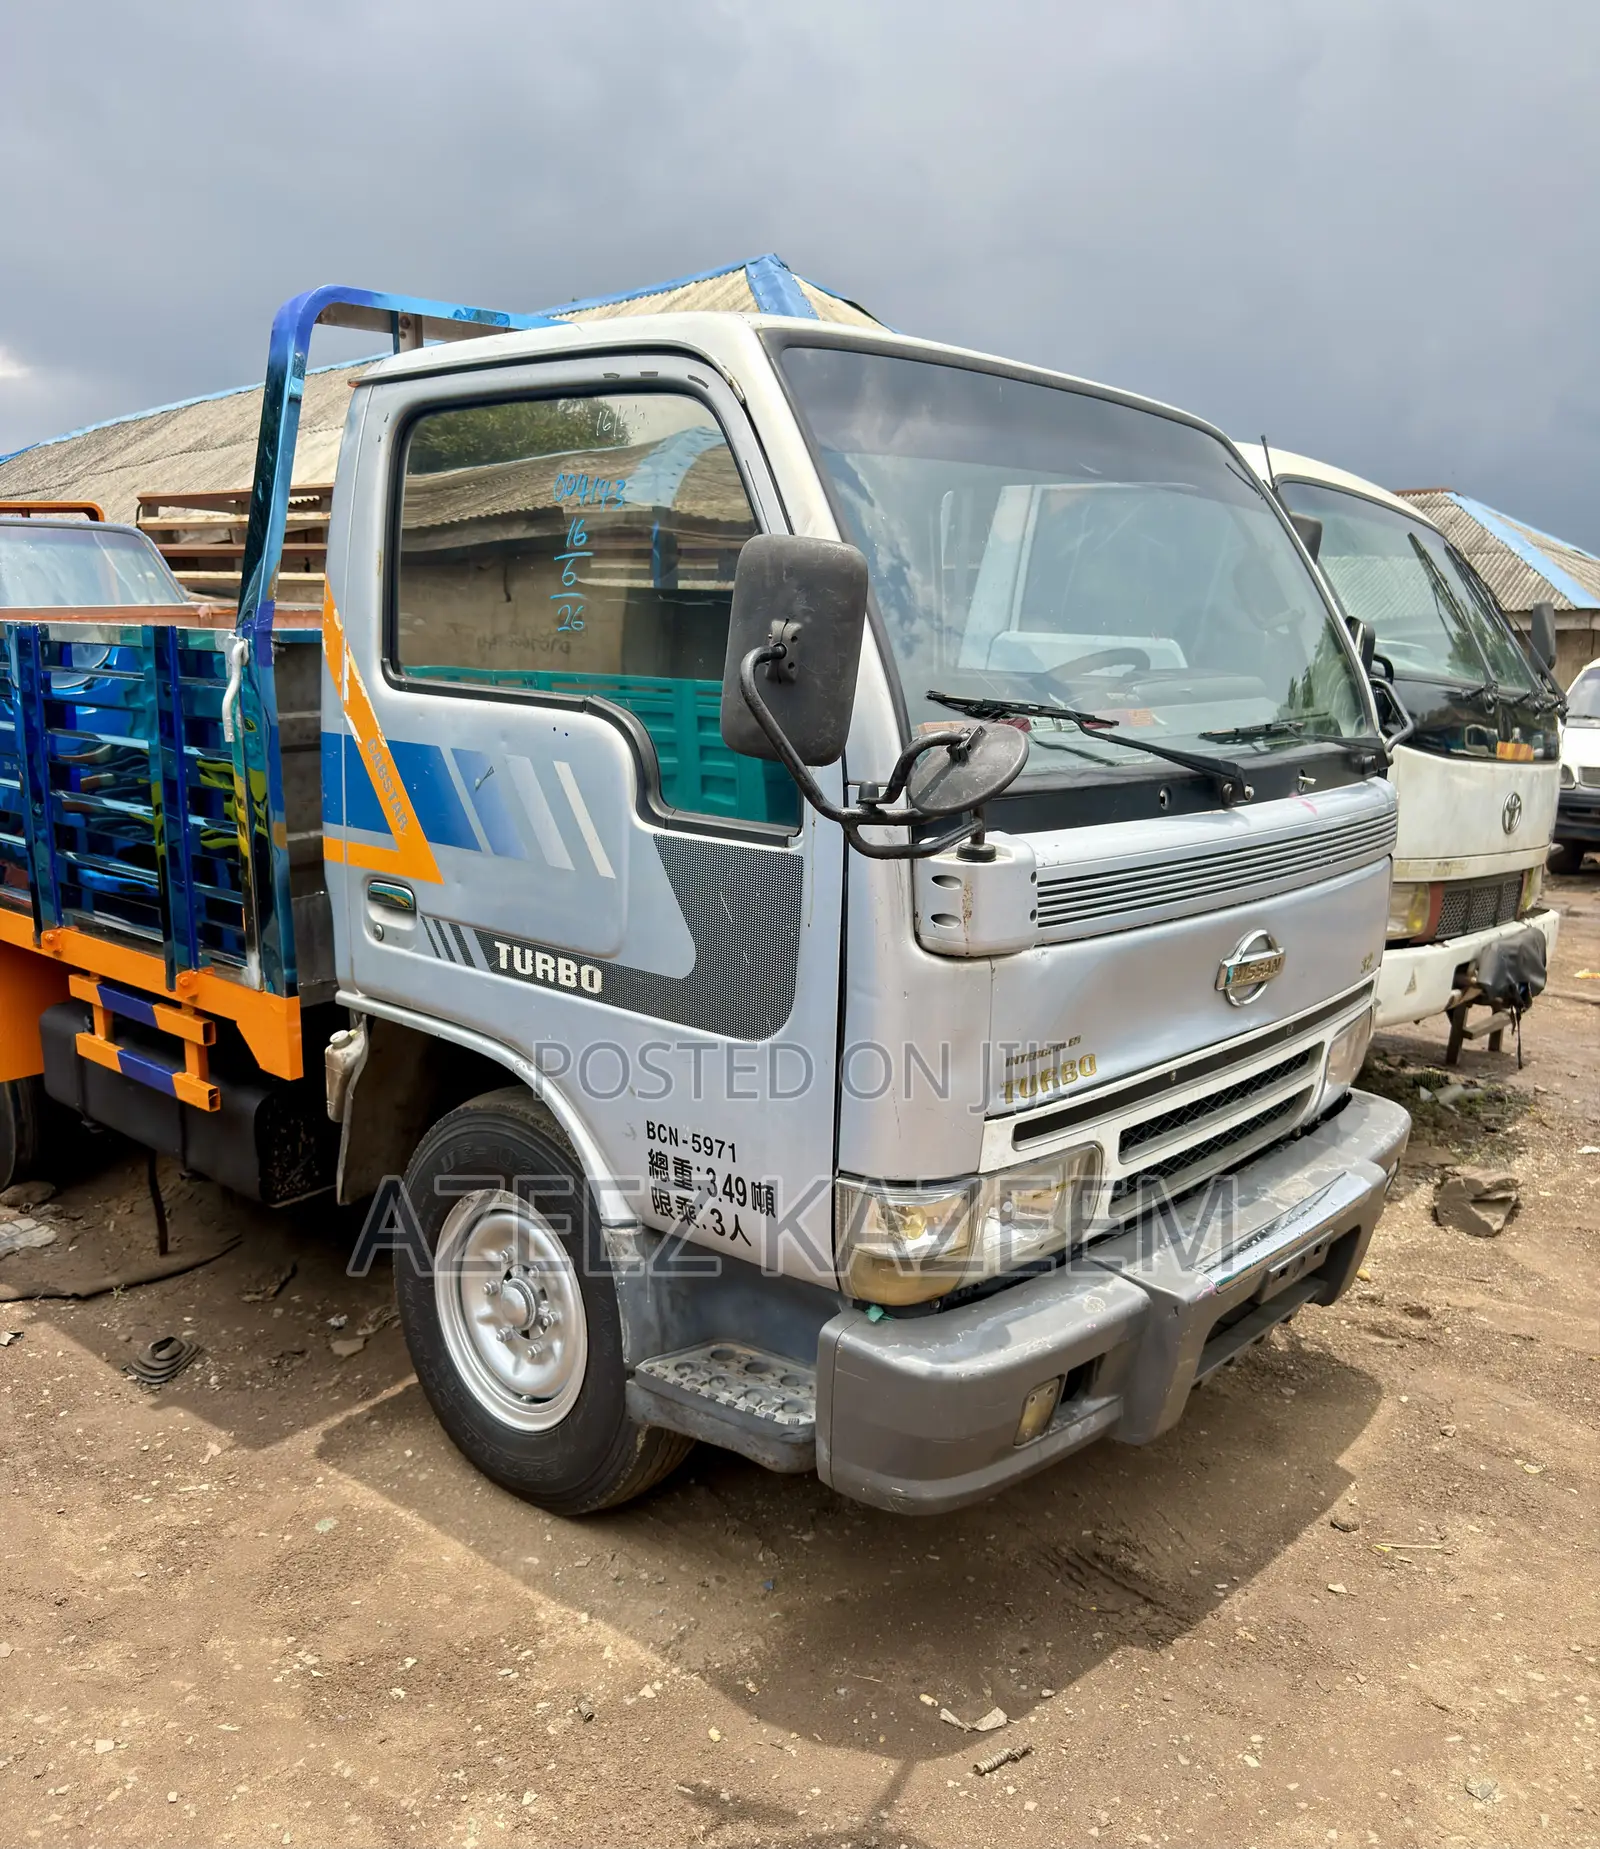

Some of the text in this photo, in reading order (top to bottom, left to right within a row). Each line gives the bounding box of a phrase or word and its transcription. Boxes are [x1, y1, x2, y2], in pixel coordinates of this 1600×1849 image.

[565, 519, 588, 548] 16
[557, 604, 585, 631] 26
[367, 738, 409, 832] CABSTAR
[494, 941, 602, 994] TURBO
[1232, 957, 1281, 981] NISSAN
[1000, 1053, 1097, 1104] TURBO
[646, 1120, 736, 1163] BCN-5971
